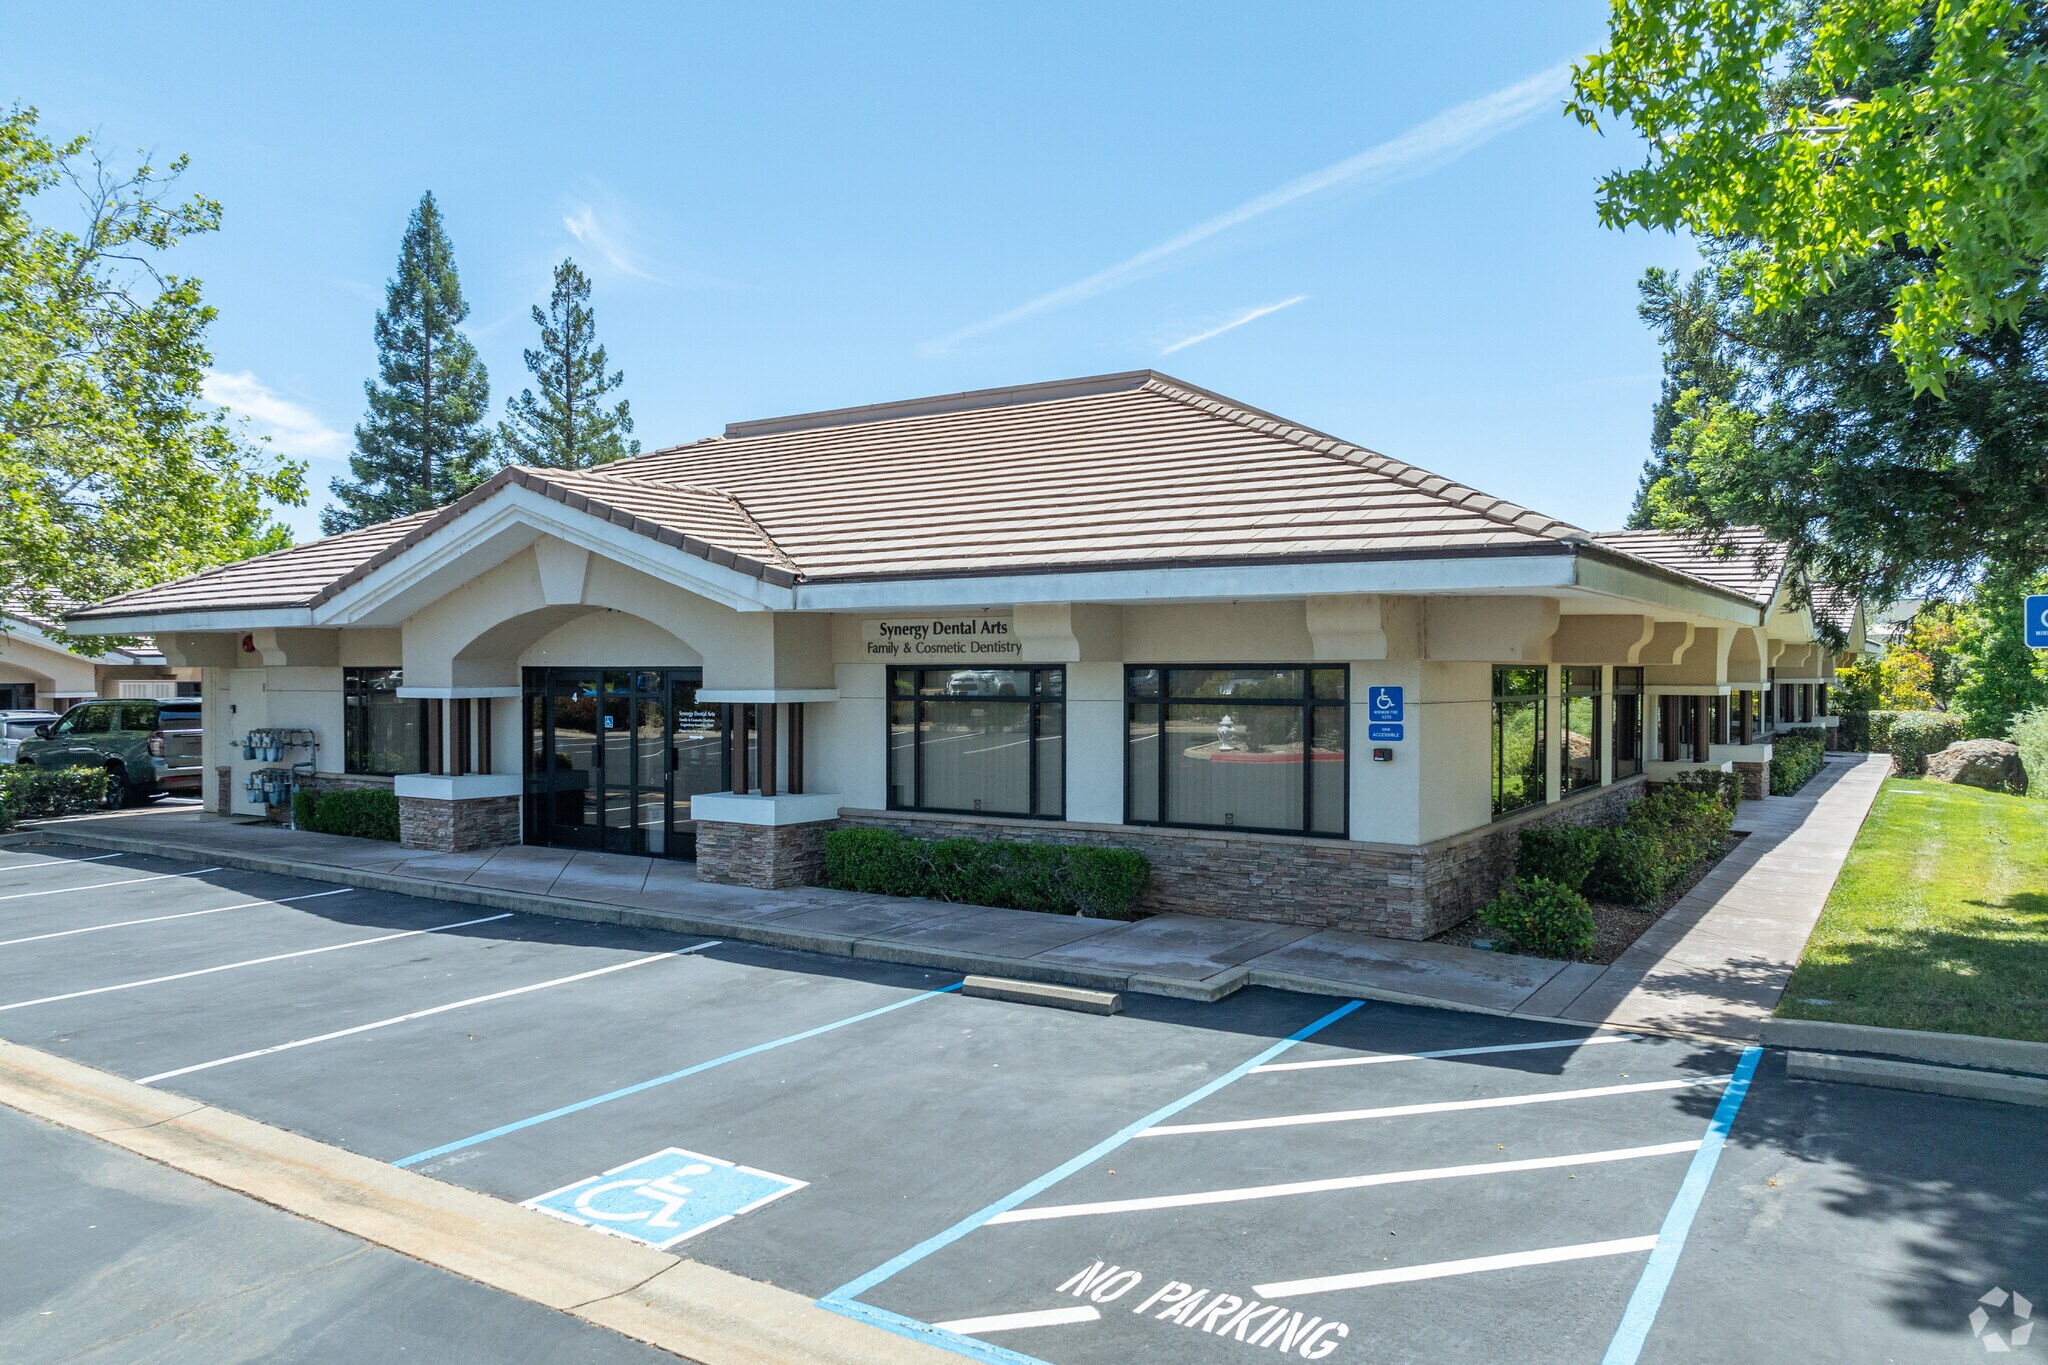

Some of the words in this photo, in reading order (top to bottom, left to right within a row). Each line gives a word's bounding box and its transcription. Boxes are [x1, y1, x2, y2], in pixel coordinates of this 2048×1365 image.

[880, 622, 929, 640] Synergy
[933, 620, 976, 635] Dental
[980, 620, 1008, 635] Arts
[867, 641, 899, 657] Family
[903, 642, 912, 653] &
[915, 641, 967, 654] Cosmetic
[970, 641, 1022, 656] Dentistry
[572, 692, 578, 702] 4
[1055, 1261, 1143, 1303] NO
[1132, 1280, 1349, 1360] PARKING
